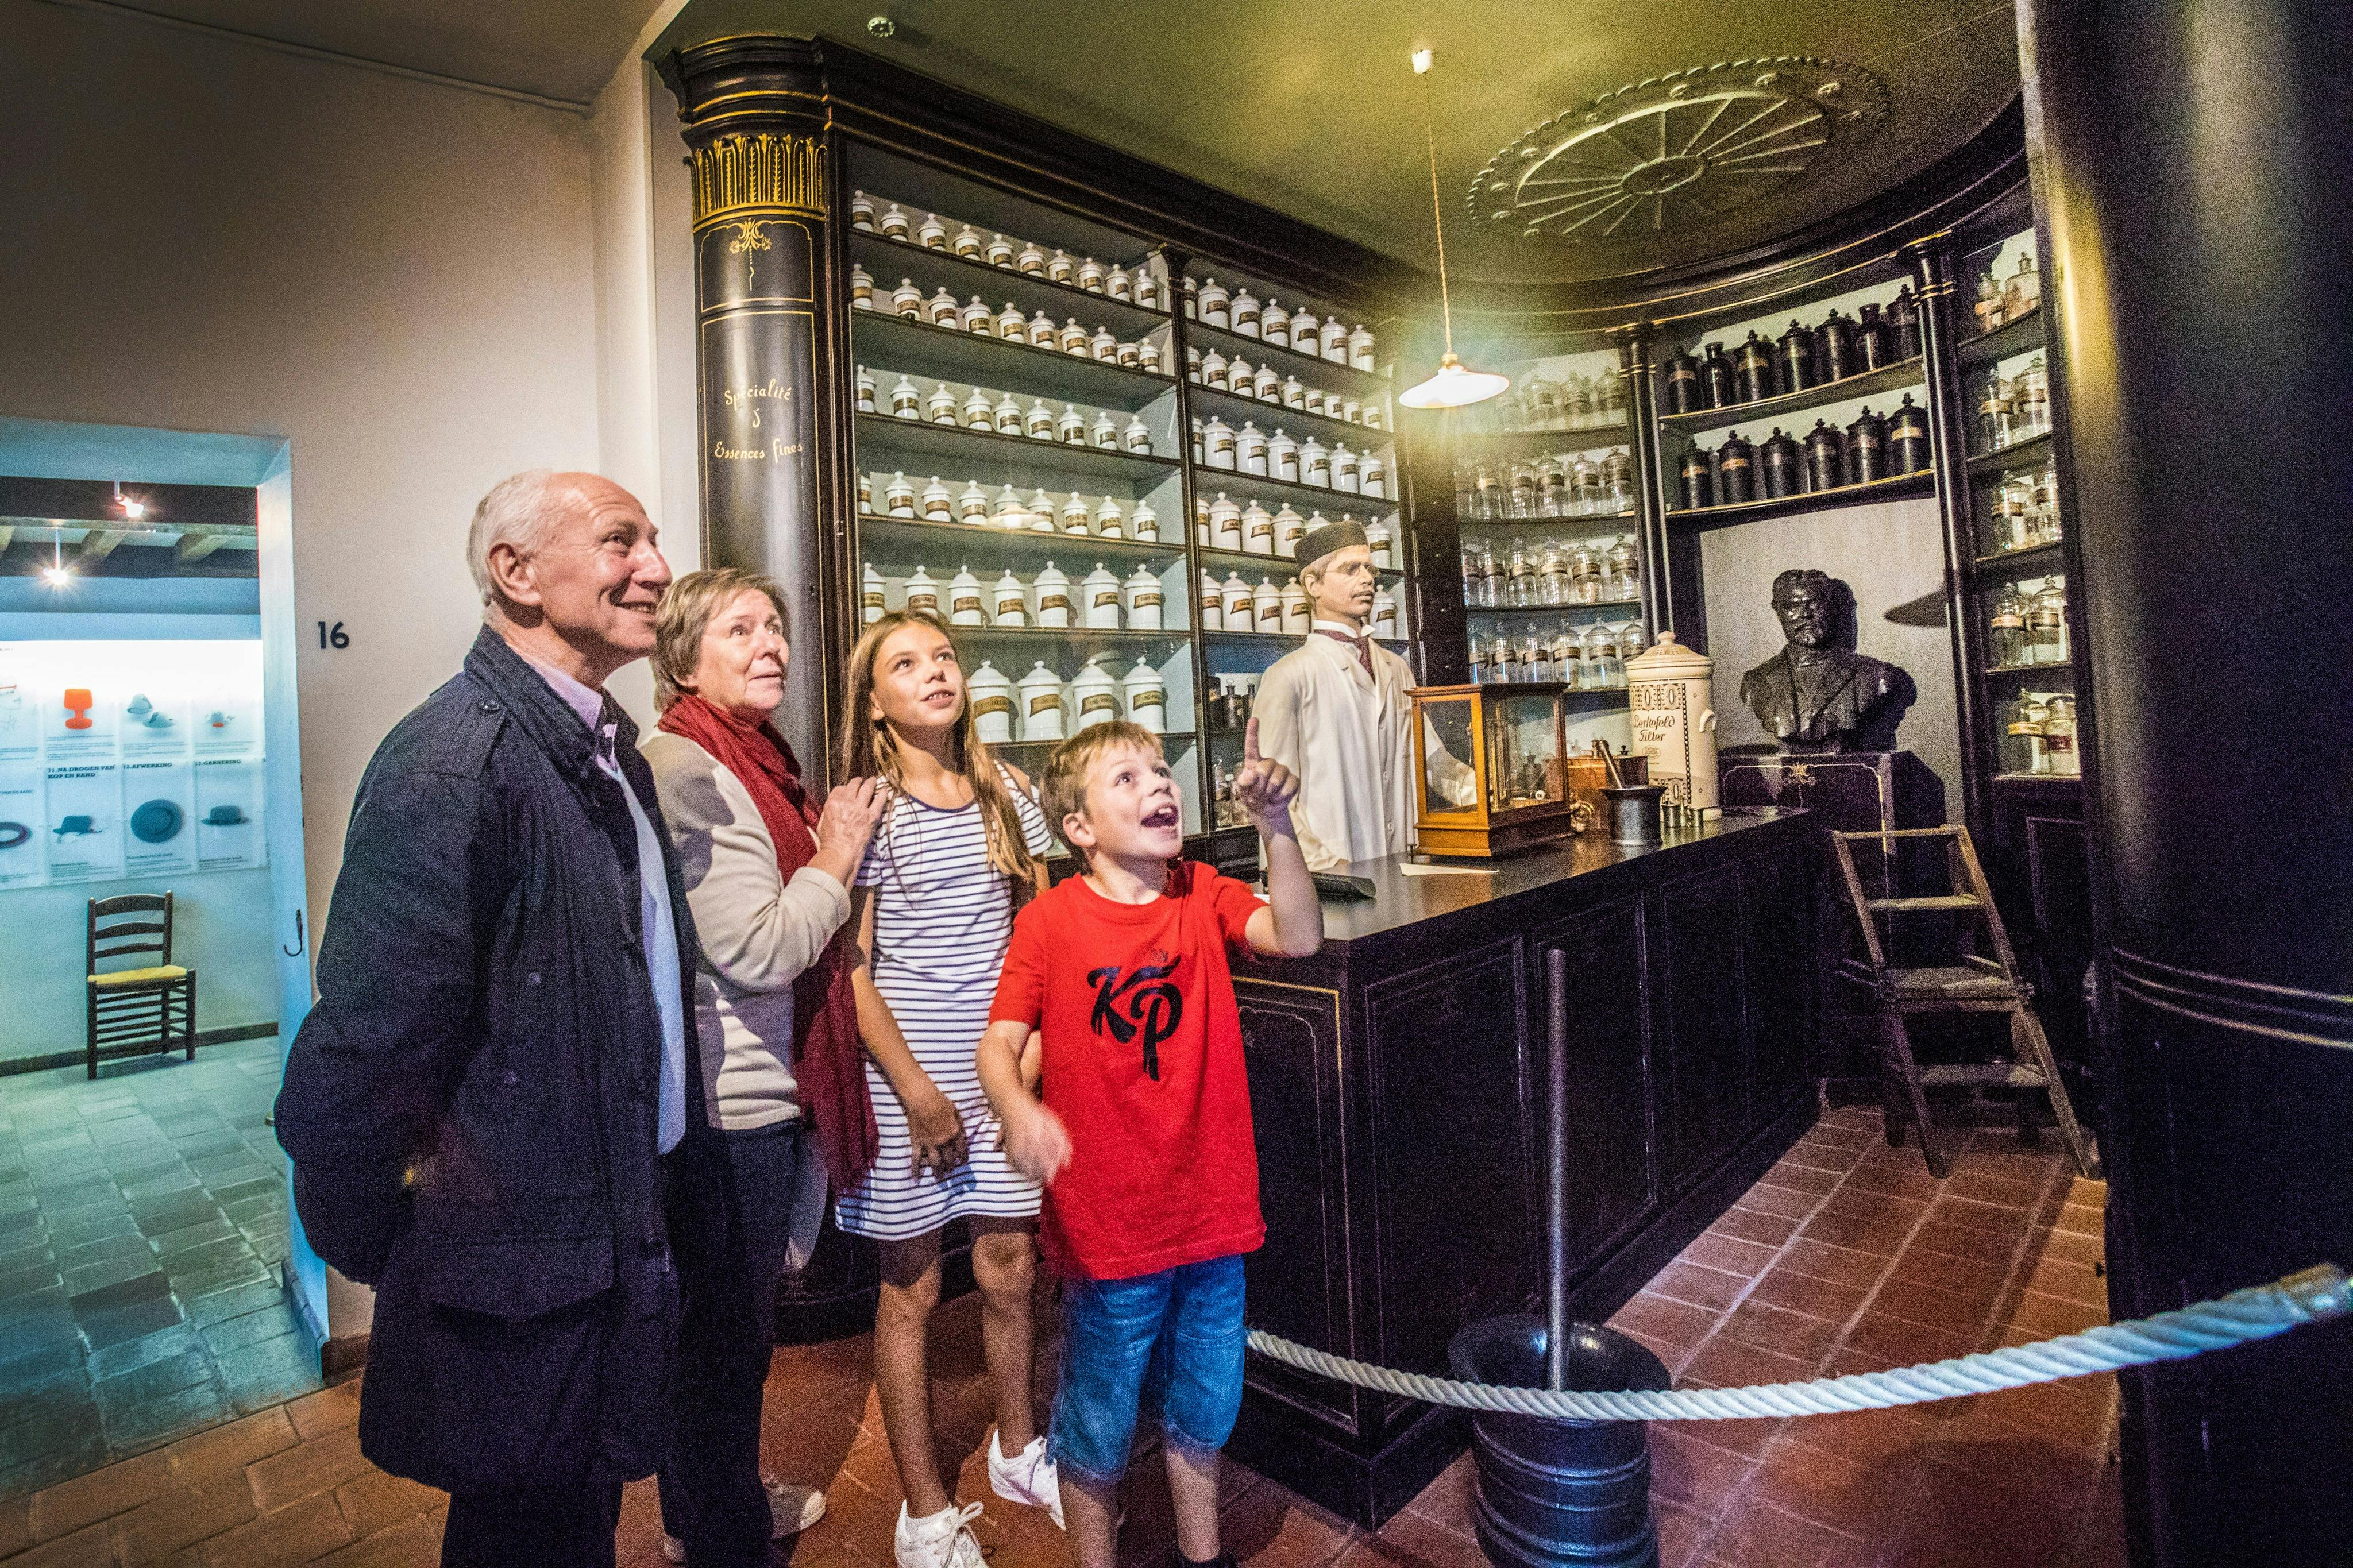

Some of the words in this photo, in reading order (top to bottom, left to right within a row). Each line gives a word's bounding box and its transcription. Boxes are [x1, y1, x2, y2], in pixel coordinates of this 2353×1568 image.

[715, 441, 765, 459] Essences
[773, 438, 803, 464] fines
[318, 621, 350, 650] 16
[1633, 715, 1675, 731] Berkefeld
[1638, 729, 1666, 742] Filter
